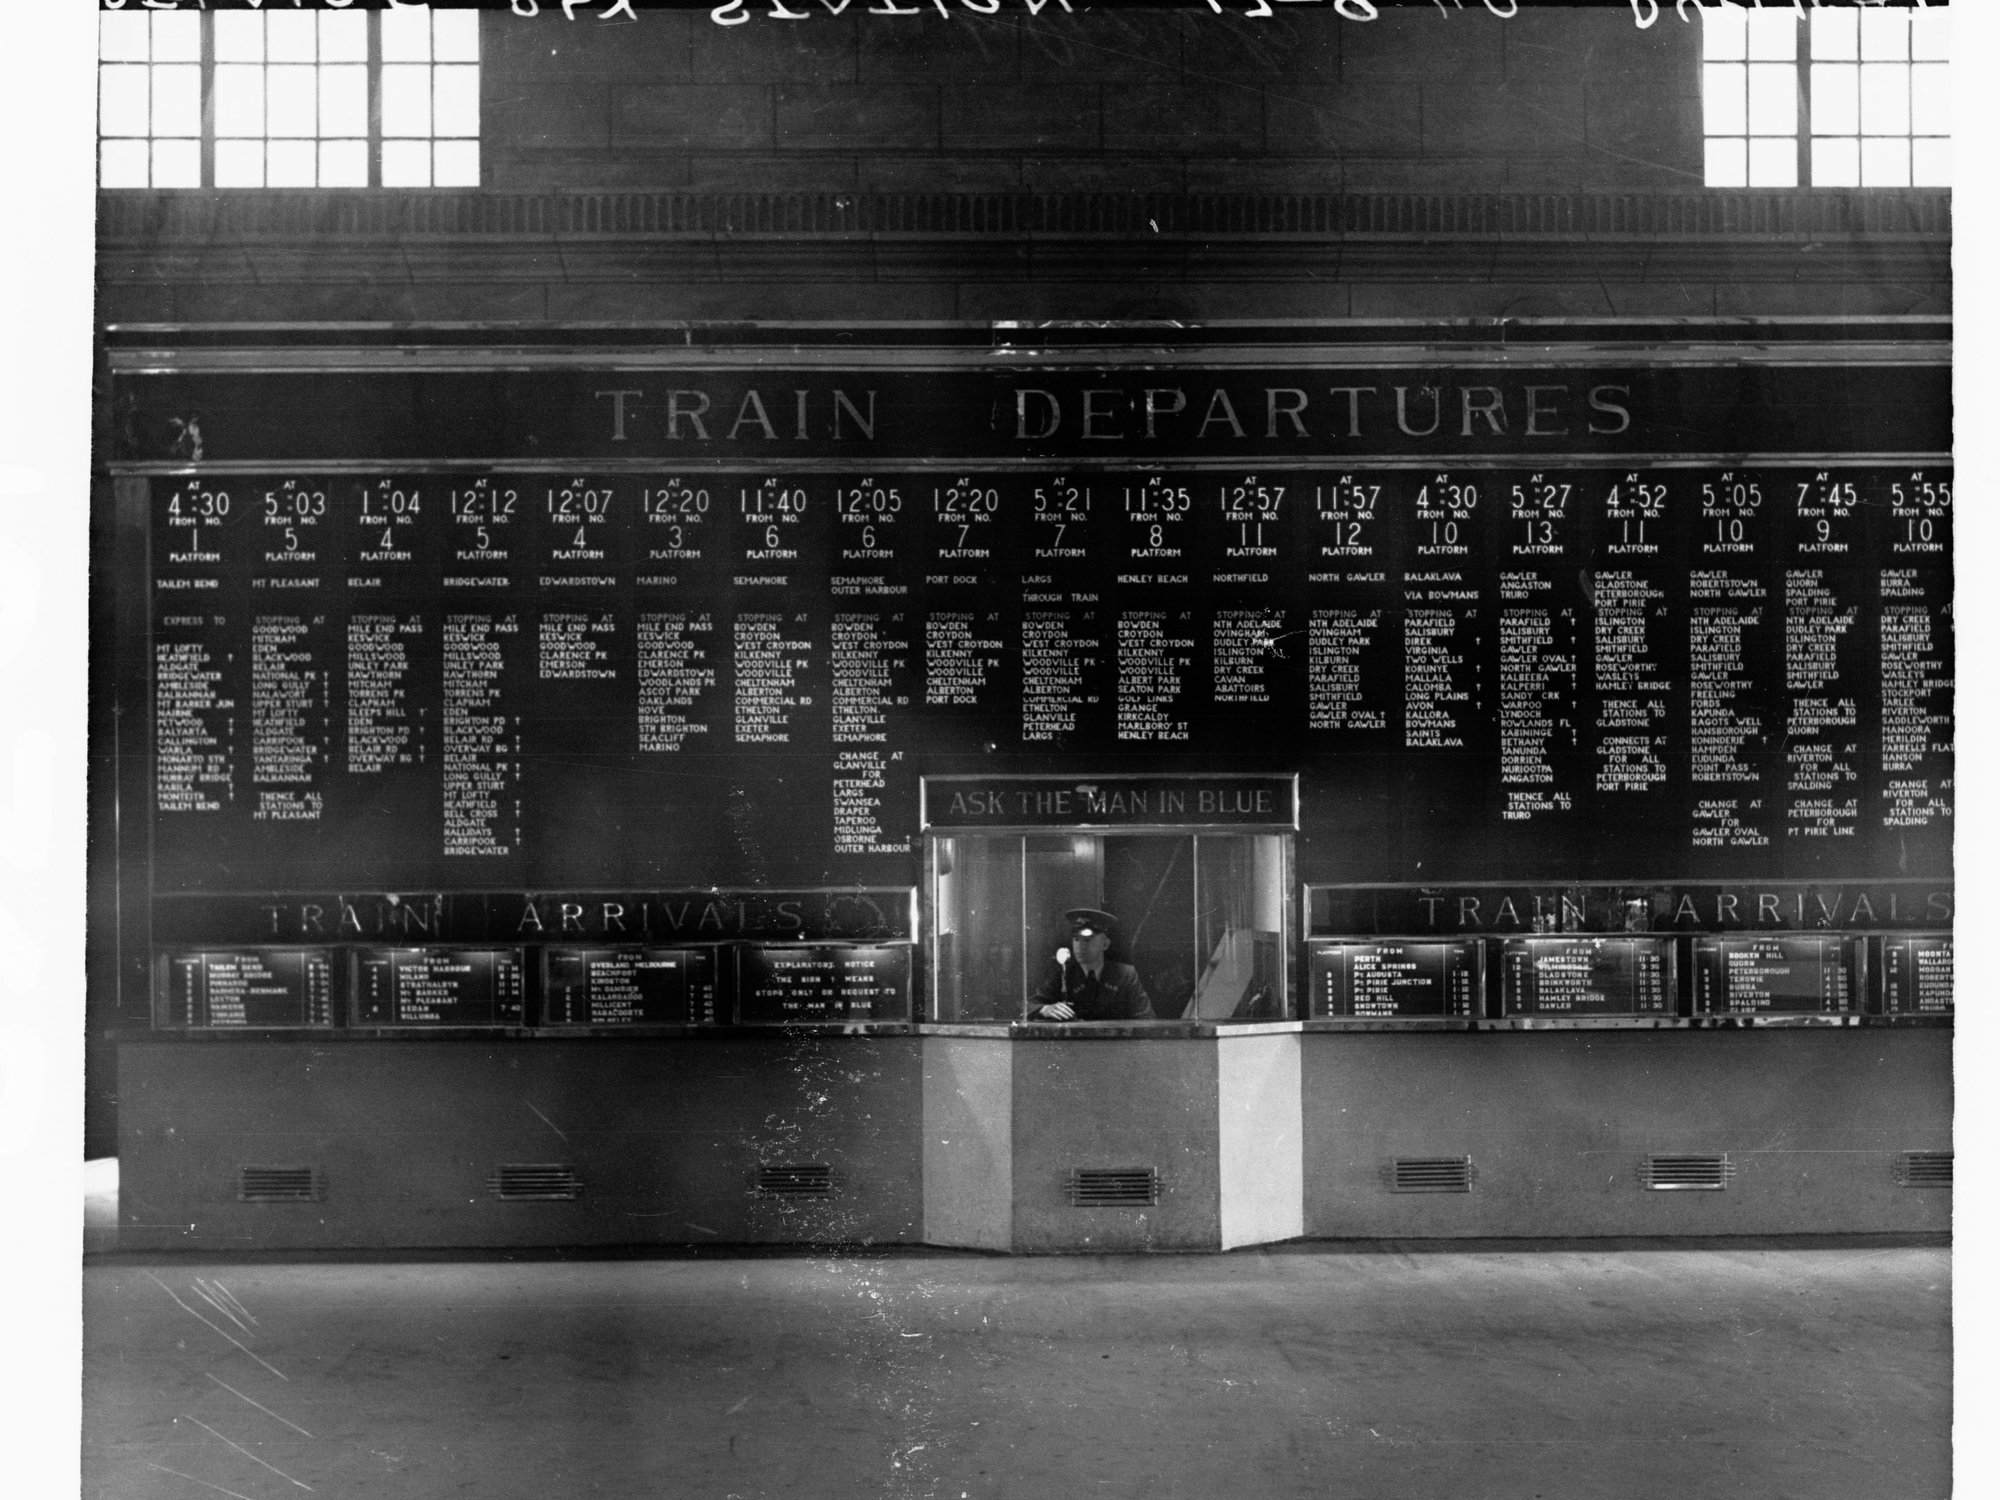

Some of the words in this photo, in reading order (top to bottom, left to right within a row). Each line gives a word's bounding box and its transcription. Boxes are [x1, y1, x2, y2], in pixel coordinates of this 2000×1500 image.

[595, 390, 879, 442] TRAIN
[1012, 384, 1634, 441] DEPARTURES
[378, 480, 391, 488] AT
[1149, 477, 1162, 485] AT
[167, 492, 231, 515] 4:30
[263, 492, 326, 515] 5:03
[362, 491, 422, 514] 1:04
[451, 491, 518, 514] 12:12
[547, 490, 614, 513] 12:07
[643, 490, 710, 513] 12:20
[740, 489, 808, 512] 11:40
[836, 489, 903, 512] 12:05
[933, 488, 999, 511] 12:20
[1034, 488, 1091, 511] 5:21
[1124, 487, 1192, 510] 11:35
[1220, 487, 1286, 510] 12:57
[1316, 486, 1382, 509] 11:57
[1415, 486, 1478, 509] 4:30
[1510, 485, 1573, 508] 5:27
[1605, 485, 1668, 508] 4:52
[1701, 484, 1763, 507] 5:05
[1796, 484, 1860, 507] 7:45
[1890, 483, 1951, 506] 5:55
[648, 514, 677, 522] FROM
[685, 514, 703, 522] NO.
[1703, 508, 1730, 516] FROM
[1739, 508, 1756, 516] NO.
[192, 528, 199, 551] 1
[284, 528, 299, 551] 5
[379, 527, 394, 550] 4
[476, 526, 490, 549] 5
[572, 526, 587, 549] 4
[668, 526, 683, 549] 3
[765, 525, 780, 548] 6
[861, 524, 876, 547] 6
[957, 524, 971, 547] 7
[1053, 524, 1067, 547] 7
[1149, 523, 1163, 546] 8
[1241, 522, 1263, 545] 11
[1335, 522, 1363, 545] 12
[1432, 522, 1459, 545] 10
[1527, 521, 1553, 544] 13
[1623, 520, 1645, 543] 11
[1717, 520, 1744, 543] 10
[1815, 520, 1831, 543] 9
[1907, 519, 1934, 542] 10
[169, 552, 221, 562] PLATFORM
[360, 551, 412, 560] PLATFORM
[552, 550, 604, 559] PLATFORM
[746, 550, 798, 558] PLATFORM
[939, 549, 990, 557] PLATFORM
[1131, 549, 1181, 557] PLATFORM
[1321, 547, 1373, 555] PLATFORM
[1512, 545, 1565, 554] PLATFORM
[1703, 544, 1754, 552] PLATFORM
[1893, 543, 1943, 552] PLATFORM
[156, 580, 191, 588] TAILEM
[193, 580, 219, 588] BEND
[252, 579, 267, 587] MT
[270, 579, 320, 587] PLEASANT
[347, 578, 382, 587] BELAIR
[443, 577, 510, 586] BRIDGEWATER
[539, 577, 616, 585] EDWARDSTOWN
[733, 577, 788, 585] SEMAPHORE
[1117, 575, 1153, 583] HENLEY
[1157, 575, 1188, 583] BEACH
[1213, 574, 1269, 582] NORTHFIELD
[1308, 573, 1340, 581] NORTH
[1346, 573, 1386, 581] GAWLER
[1402, 573, 1463, 581] BALAKLAVA
[1499, 572, 1537, 580] GAWLER
[1595, 571, 1632, 579] GAWLER
[1690, 570, 1728, 578] GAWLER
[1785, 570, 1823, 578] GAWLER
[1879, 569, 1918, 577] GAWLER
[831, 586, 861, 594] OUTER
[865, 586, 908, 594] HARBOUR
[1404, 591, 1423, 599] VIA
[1428, 591, 1479, 599] BOWMANS
[1690, 589, 1721, 597] NORTH
[1728, 589, 1767, 597] GAWLER
[1879, 588, 1925, 596] SPALDING
[163, 616, 203, 625] EXPRESS
[213, 616, 226, 625] TO
[949, 792, 1005, 814] ASK
[1017, 791, 1072, 814] THE
[1086, 790, 1147, 814] MAN
[1160, 790, 1184, 813] IN
[1199, 790, 1273, 813] BLUE
[1698, 800, 1738, 808] CHANGE
[1750, 800, 1763, 808] AT
[1788, 827, 1799, 835] PT
[1804, 827, 1828, 835] PIRIE
[1833, 827, 1855, 835] LINE
[261, 903, 429, 932] TRAIN
[518, 900, 803, 932] ARRIVALS
[1418, 895, 1586, 926] TRAIN
[1674, 892, 1952, 922] ARRIVALS
